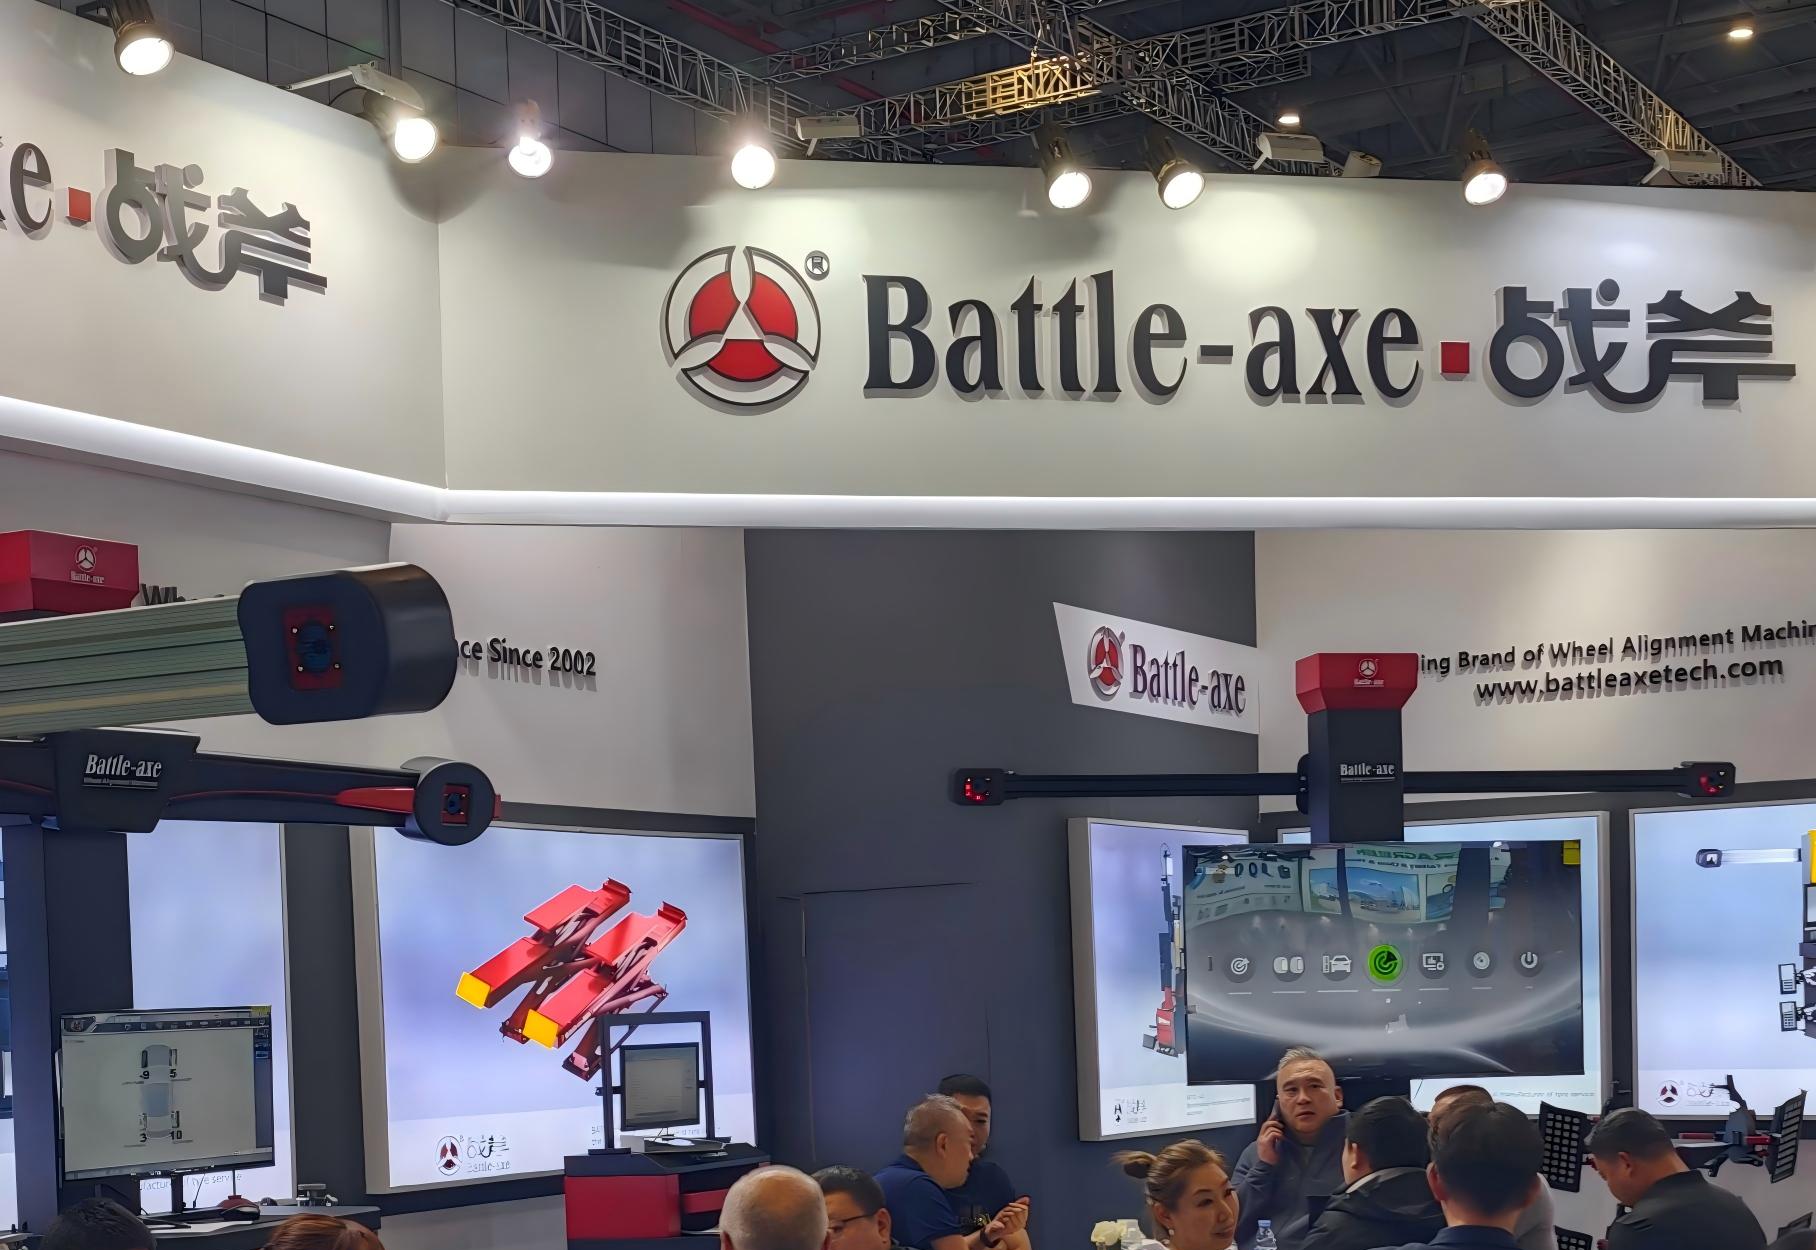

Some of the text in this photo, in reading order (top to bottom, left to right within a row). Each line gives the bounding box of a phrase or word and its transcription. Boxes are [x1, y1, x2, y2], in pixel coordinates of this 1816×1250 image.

[104, 148, 327, 303] 战斧
[862, 270, 1422, 398] Battle-axe
[1490, 278, 1796, 404] 战斧
[460, 638, 596, 676] ce Since 2002
[1421, 620, 1816, 674] ing Brand of Wheel Alignment Machin
[1131, 644, 1247, 714] Battle-axe
[1476, 659, 1784, 699] www.battleaxetech.com
[85, 754, 162, 777] Battle-axe
[1340, 763, 1394, 775] Battle-axe
